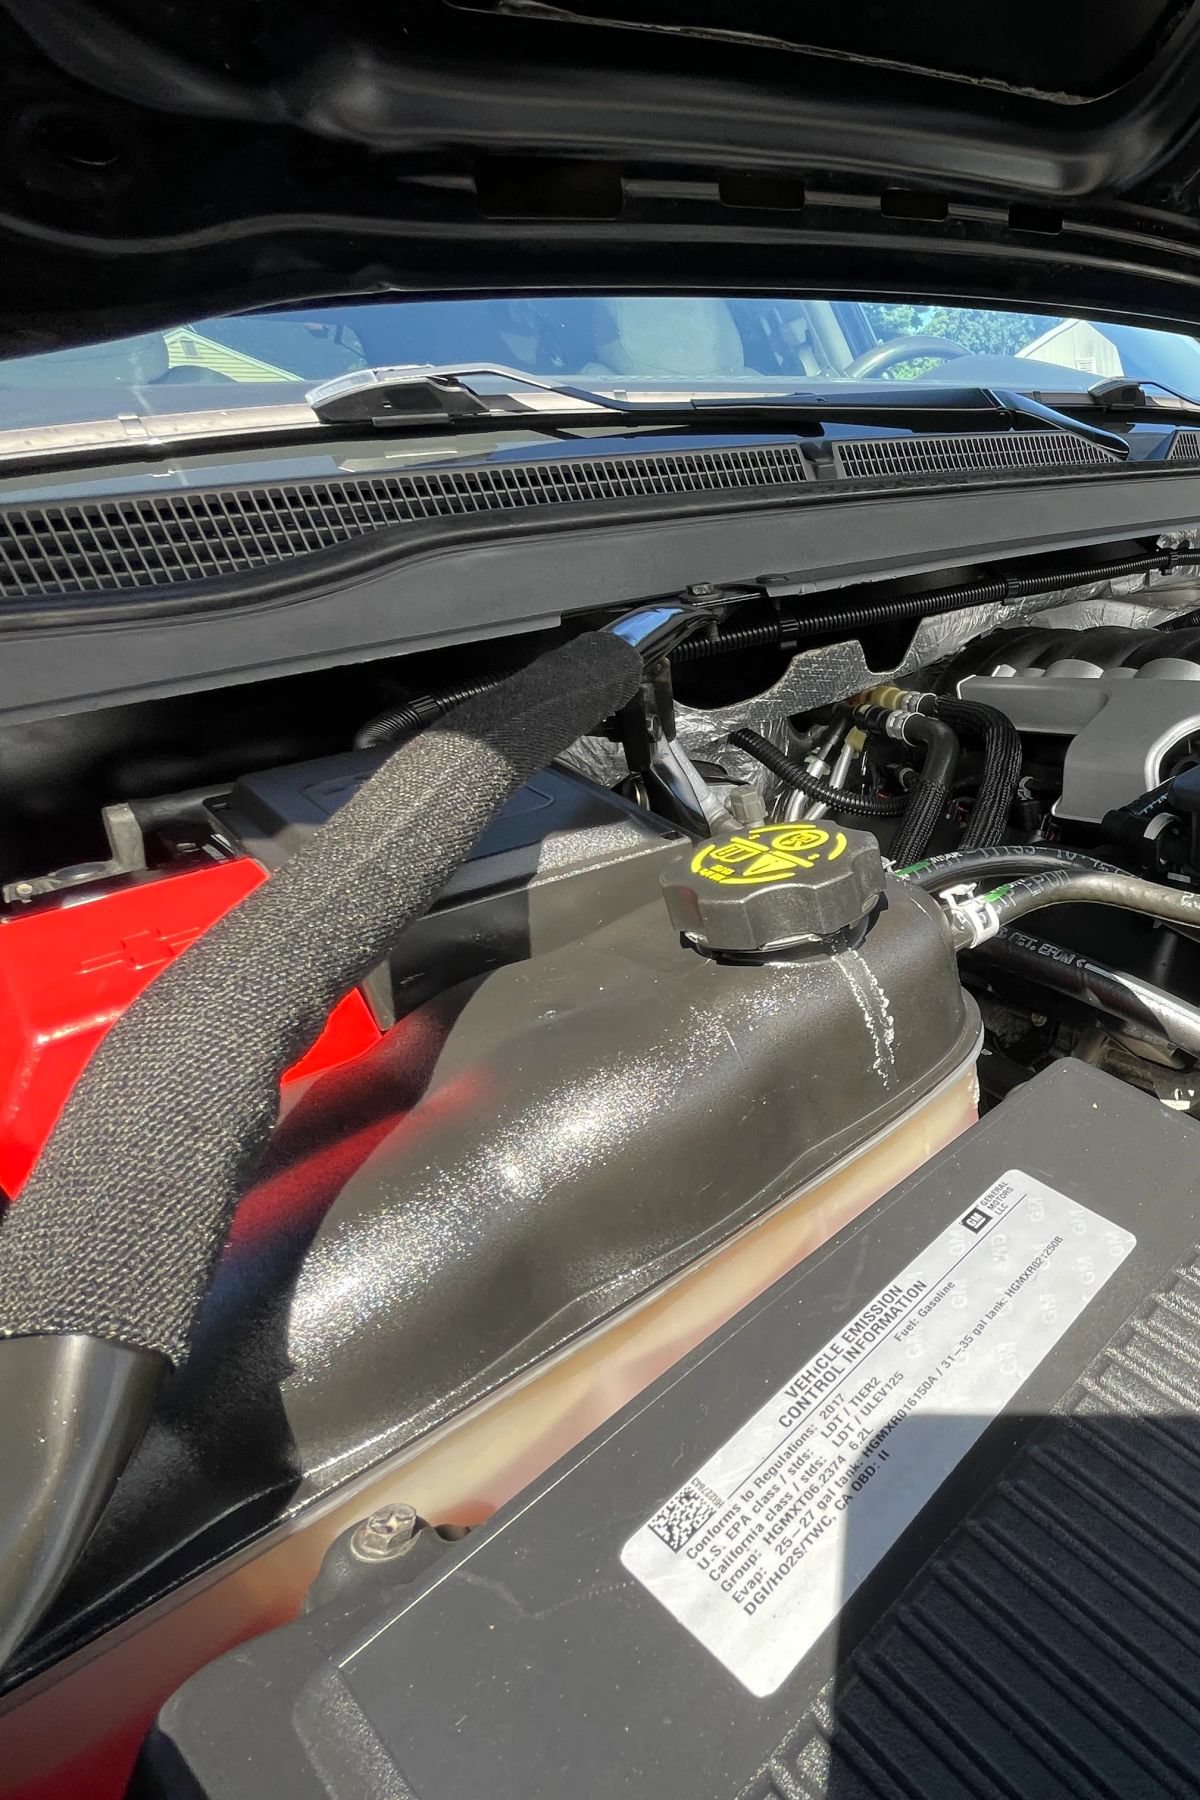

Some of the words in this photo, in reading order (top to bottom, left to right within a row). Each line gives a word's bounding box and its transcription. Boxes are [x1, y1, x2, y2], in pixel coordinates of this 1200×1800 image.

[963, 1211, 985, 1228] GM
[979, 1179, 1009, 1206] GENERAL
[986, 1185, 1014, 1211] MOTORS
[993, 1202, 1009, 1215] LLC
[776, 1361, 846, 1429] CONTROL
[841, 1279, 928, 1363] INFORMATION
[784, 1342, 844, 1400] VEHICLE
[840, 1283, 903, 1344] EMISSION
[893, 1316, 920, 1342] Fuel:
[916, 1280, 955, 1318] Gasoline
[684, 1501, 742, 1560] Conforms
[739, 1487, 756, 1503] to
[752, 1422, 819, 1490] Regulations:
[818, 1392, 847, 1420] 2017
[696, 1539, 727, 1571] U.S.
[724, 1512, 752, 1541] EPA
[749, 1482, 781, 1514] class
[785, 1446, 815, 1476] stds:
[819, 1413, 845, 1439] LDT
[848, 1375, 882, 1408] TIER2
[707, 1520, 766, 1583] California
[762, 1489, 794, 1522] class
[798, 1453, 828, 1483] stds:
[830, 1422, 857, 1448] LDT
[859, 1370, 906, 1417] ULEV125
[718, 1546, 764, 1595] Group:
[761, 1453, 848, 1546] HGMXT06.2374
[847, 1423, 874, 1451] 6.2L
[730, 1564, 769, 1605] Evap:
[813, 1487, 838, 1512] gal
[832, 1456, 864, 1489] tank:
[860, 1373, 939, 1458] HGMXR016150A
[969, 1318, 989, 1336] gal
[983, 1296, 1009, 1320] tank:
[832, 1490, 854, 1512] CA
[849, 1459, 881, 1492] OBD:
